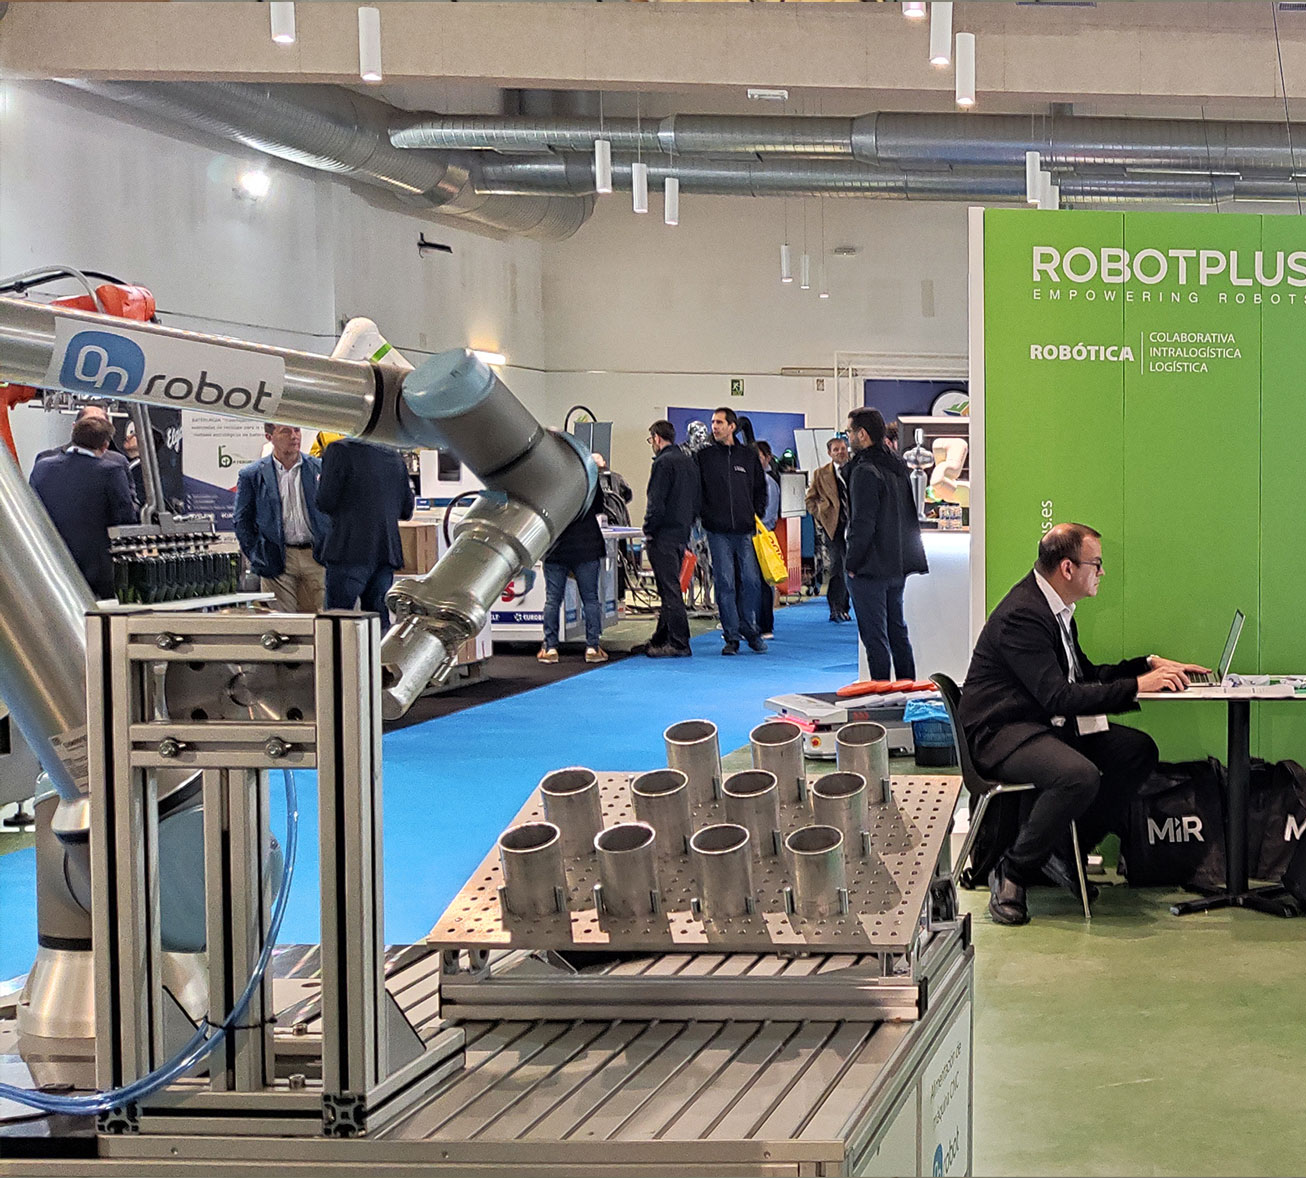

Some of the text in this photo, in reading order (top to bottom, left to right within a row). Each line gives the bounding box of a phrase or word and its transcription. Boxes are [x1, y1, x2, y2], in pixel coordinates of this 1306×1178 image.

[1033, 289, 1199, 304] EMPOWERING
[1149, 331, 1236, 344] COLABORATIVA
[1029, 342, 1135, 362] ROBÓTICA
[1149, 345, 1242, 360] INTRALOGÍSTICA
[1149, 359, 1209, 373] LOGÍSTICA
